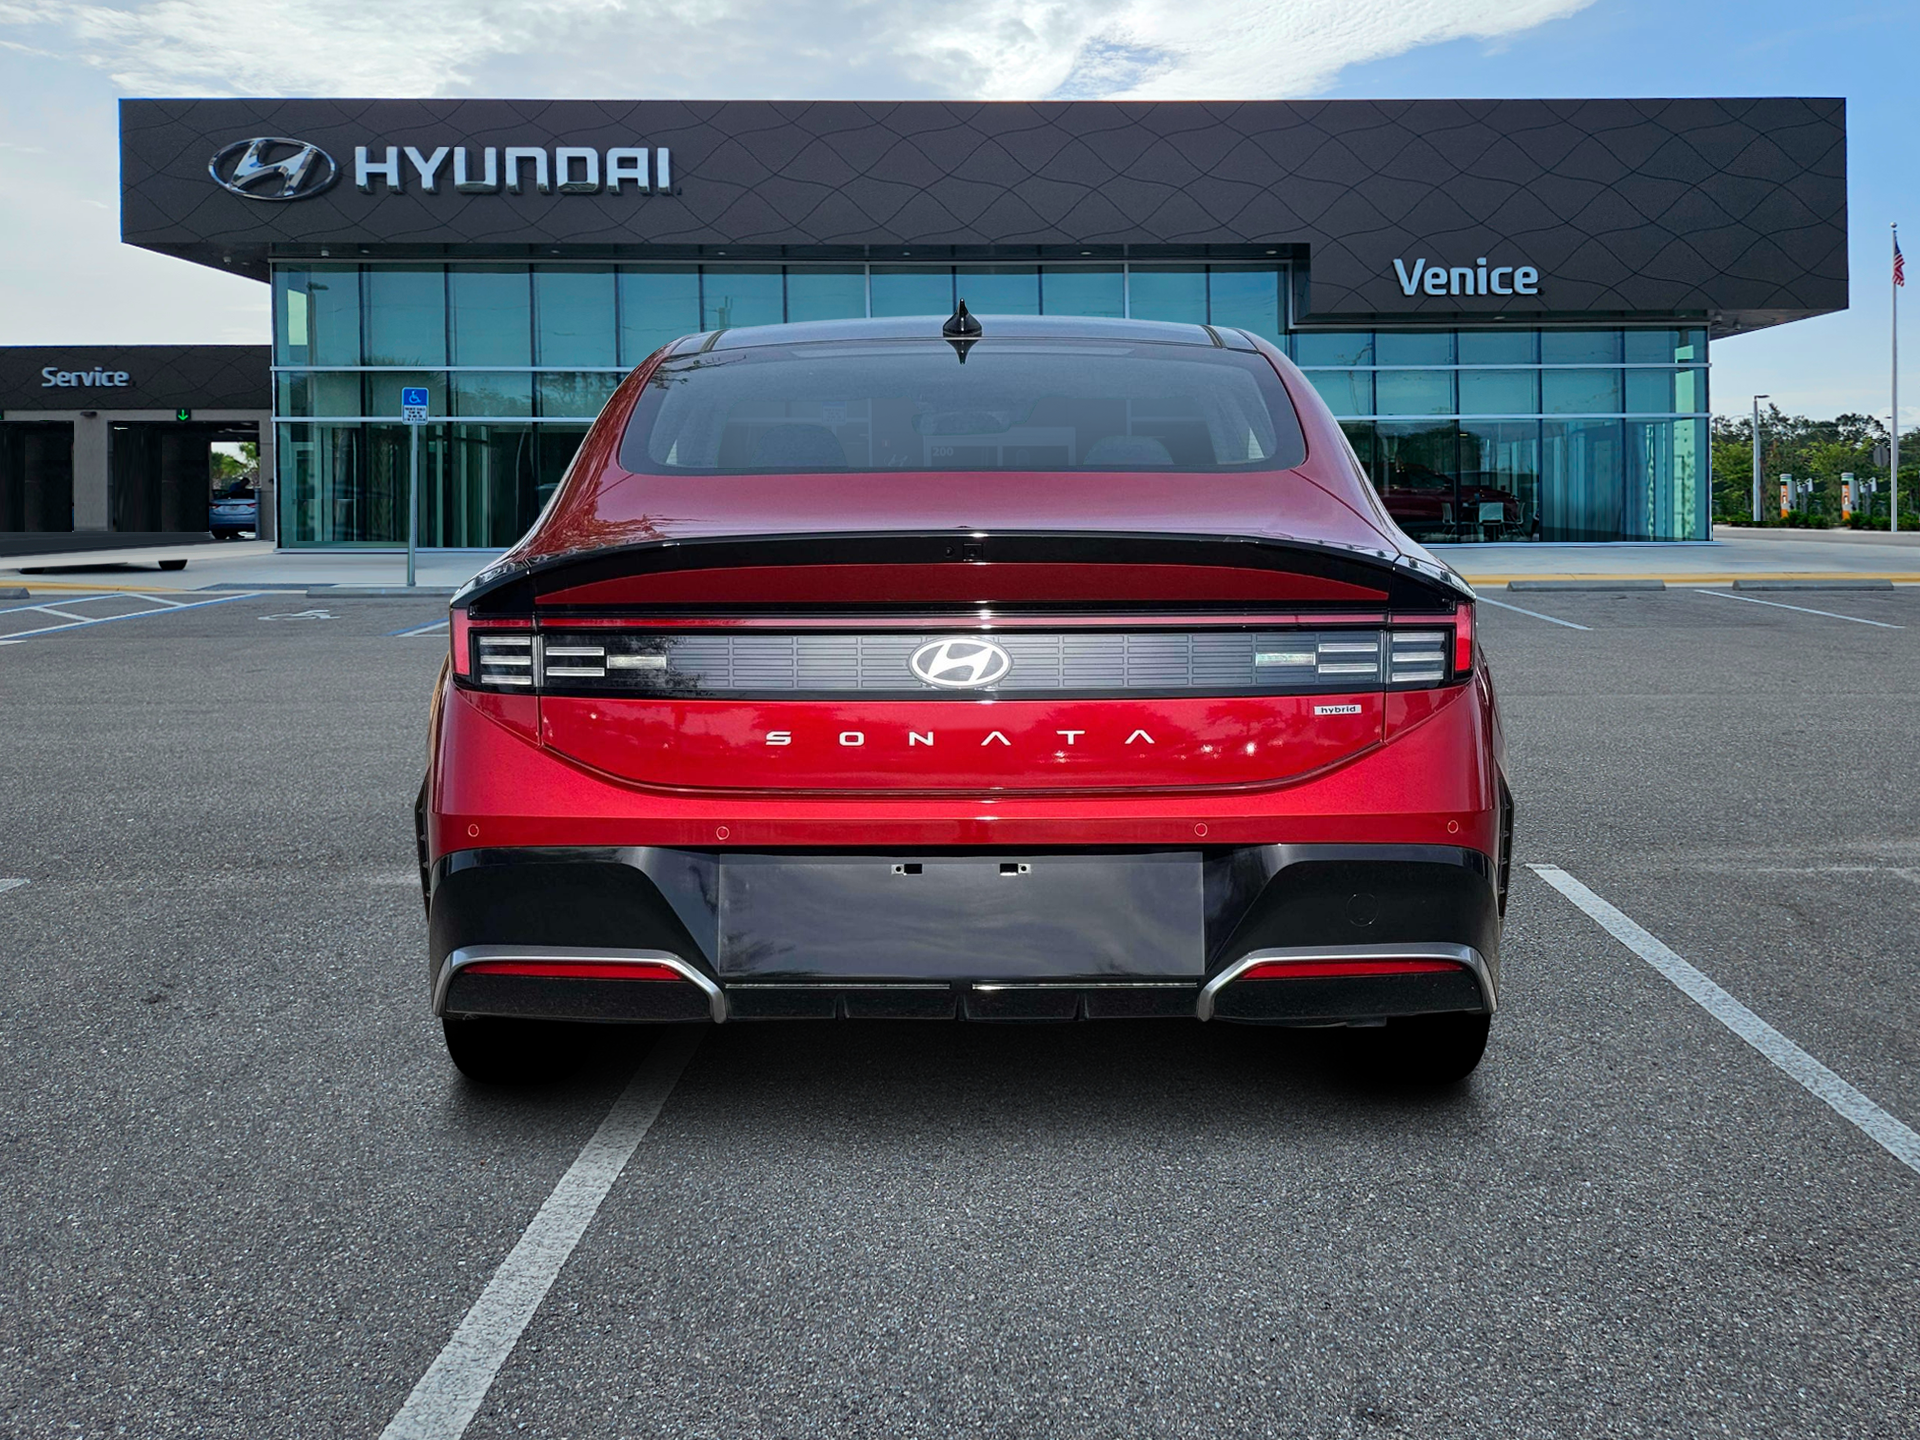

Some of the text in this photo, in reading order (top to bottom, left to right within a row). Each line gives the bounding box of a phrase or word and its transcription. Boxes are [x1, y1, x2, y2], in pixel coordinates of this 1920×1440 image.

[354, 146, 672, 193] HYUNDAI
[1392, 257, 1539, 296] Venice
[41, 366, 129, 387] Service
[932, 446, 954, 457] 200
